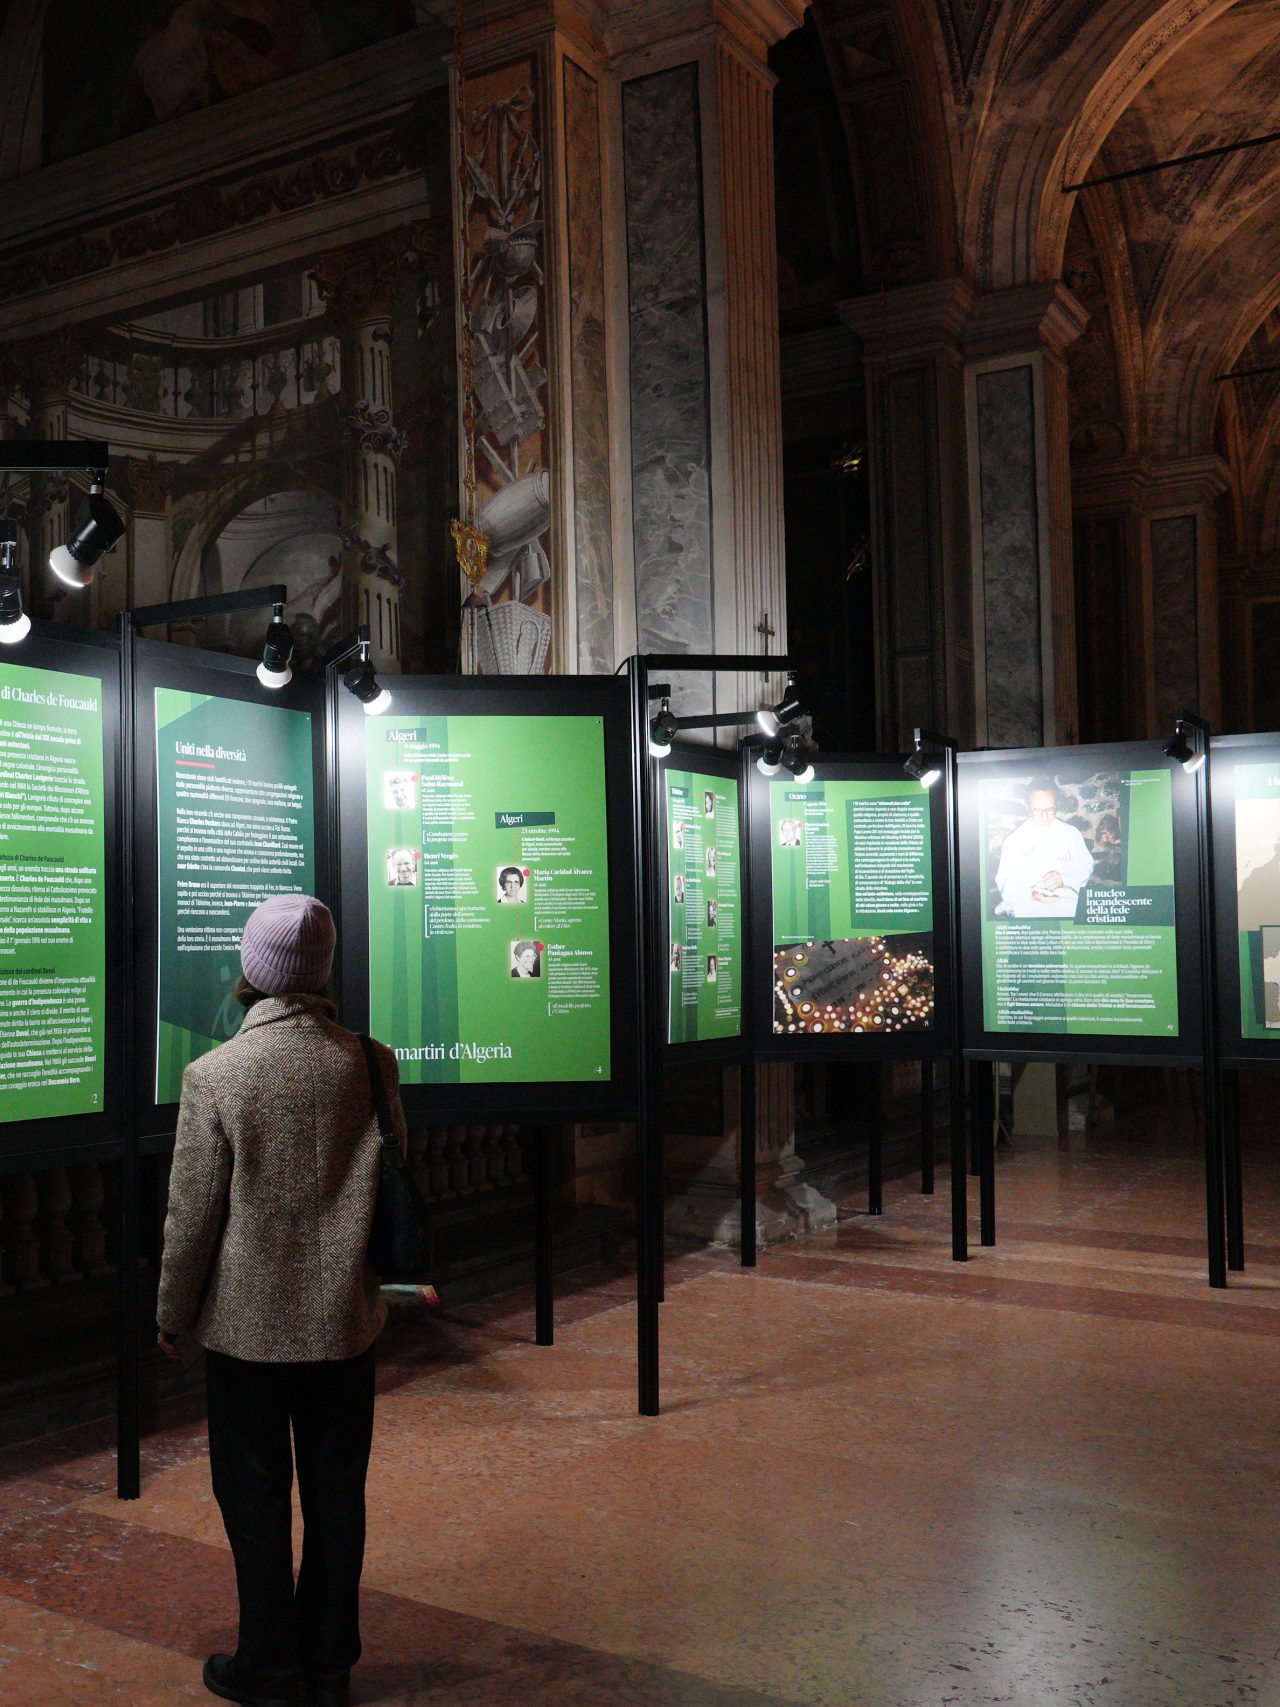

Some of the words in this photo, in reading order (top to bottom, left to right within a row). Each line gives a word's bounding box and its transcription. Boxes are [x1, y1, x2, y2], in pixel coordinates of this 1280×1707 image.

[1, 686, 11, 700] di
[12, 688, 46, 704] Charles
[46, 692, 58, 706] de
[59, 694, 98, 712] Foucauld
[388, 730, 417, 743] Algeri
[176, 742, 195, 756] Uniti
[196, 745, 215, 758] nella
[215, 746, 246, 762] diversità
[500, 814, 523, 825] Algeri
[1086, 889, 1092, 897] Il
[1095, 889, 1125, 897] nucleo
[1086, 897, 1152, 905] incandescente
[1087, 905, 1108, 914] della
[1110, 906, 1130, 914] fede
[1087, 914, 1126, 923] cristiana
[395, 1044, 445, 1060] martiri
[449, 1042, 512, 1063] d'Algeria
